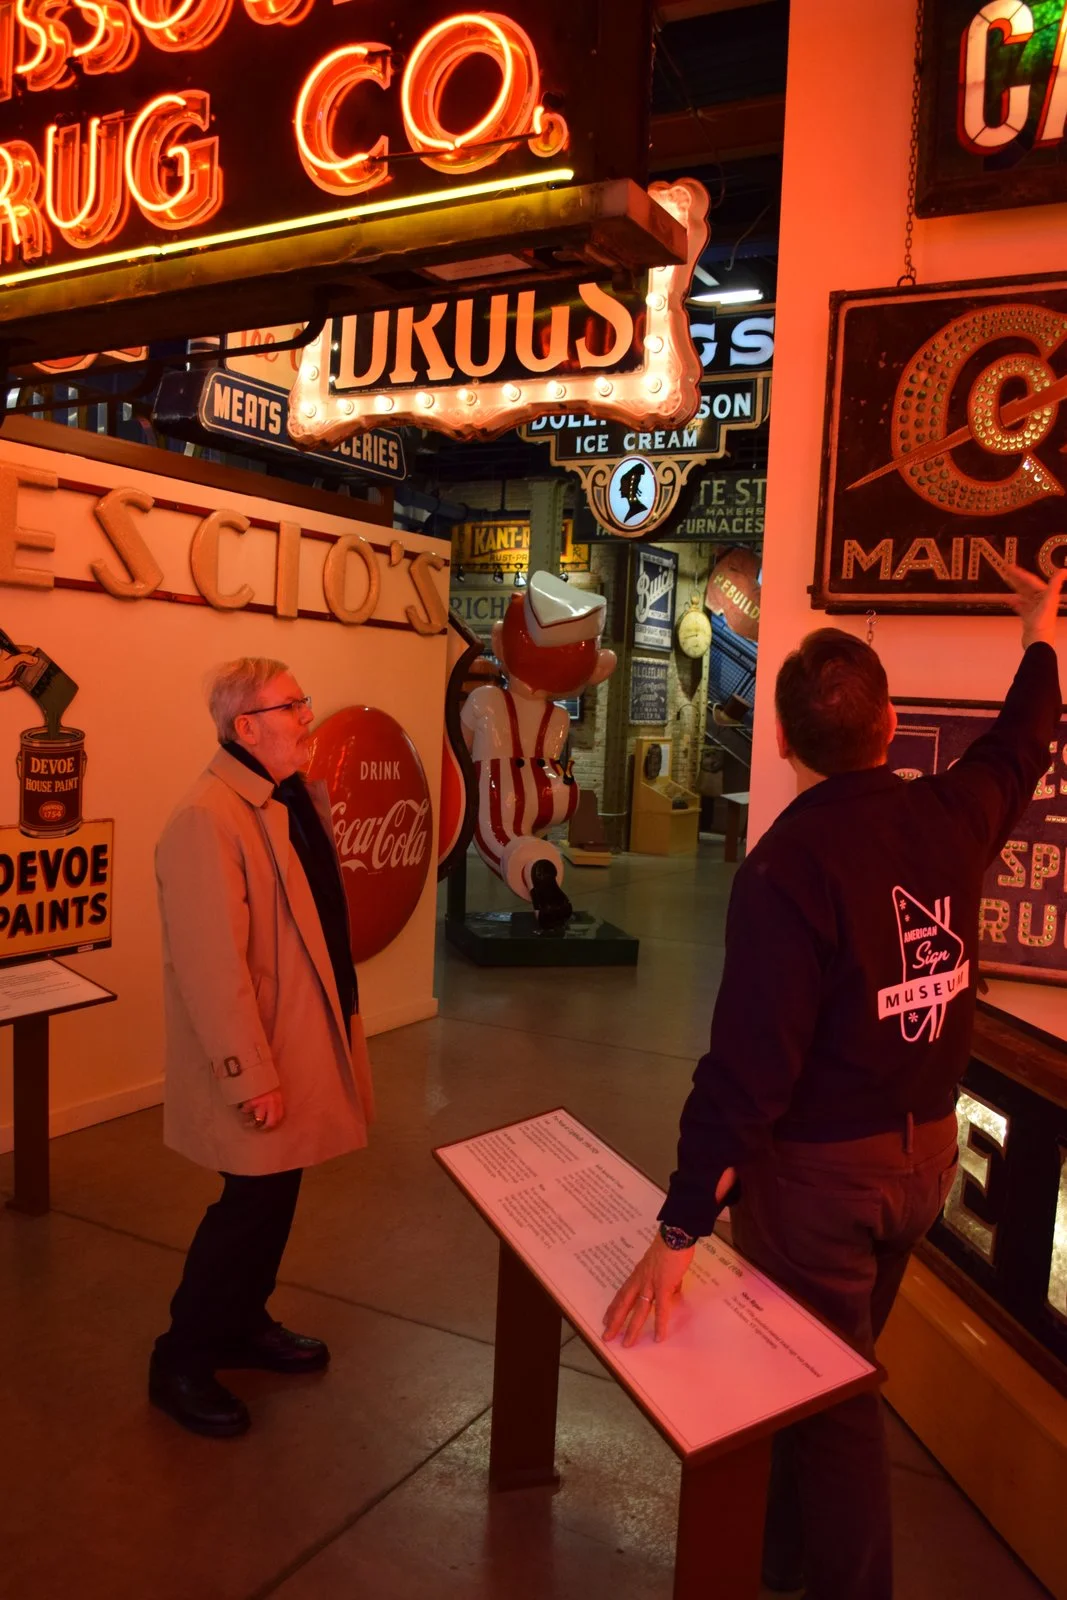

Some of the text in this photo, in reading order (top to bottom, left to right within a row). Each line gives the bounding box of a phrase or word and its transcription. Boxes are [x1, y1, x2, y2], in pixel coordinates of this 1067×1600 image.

[295, 12, 569, 196] CO.
[689, 315, 776, 368] GS
[212, 382, 399, 471] MEATS CERIES
[530, 392, 752, 431] DOLL SON
[575, 429, 699, 454] ICE CREAM
[698, 478, 767, 506] TE ST
[675, 517, 765, 536] FURNACES
[705, 507, 765, 517] MAKERS
[473, 525, 531, 556] KANT-R
[488, 552, 529, 562] RUST-PR
[841, 535, 1018, 582] MAIN
[450, 595, 512, 620] RICH
[712, 573, 762, 620] REBUILD
[30, 756, 75, 775] DEVOE
[360, 760, 401, 782] DRINK
[25, 776, 79, 793] HOUSE PAINT
[330, 798, 430, 873] oca-Cola
[0, 843, 109, 897] DEVOE
[0, 892, 108, 939] PAINTS
[903, 925, 938, 944] AMERICAN
[912, 939, 951, 976] Sign
[885, 970, 965, 1010] MUSEUM
